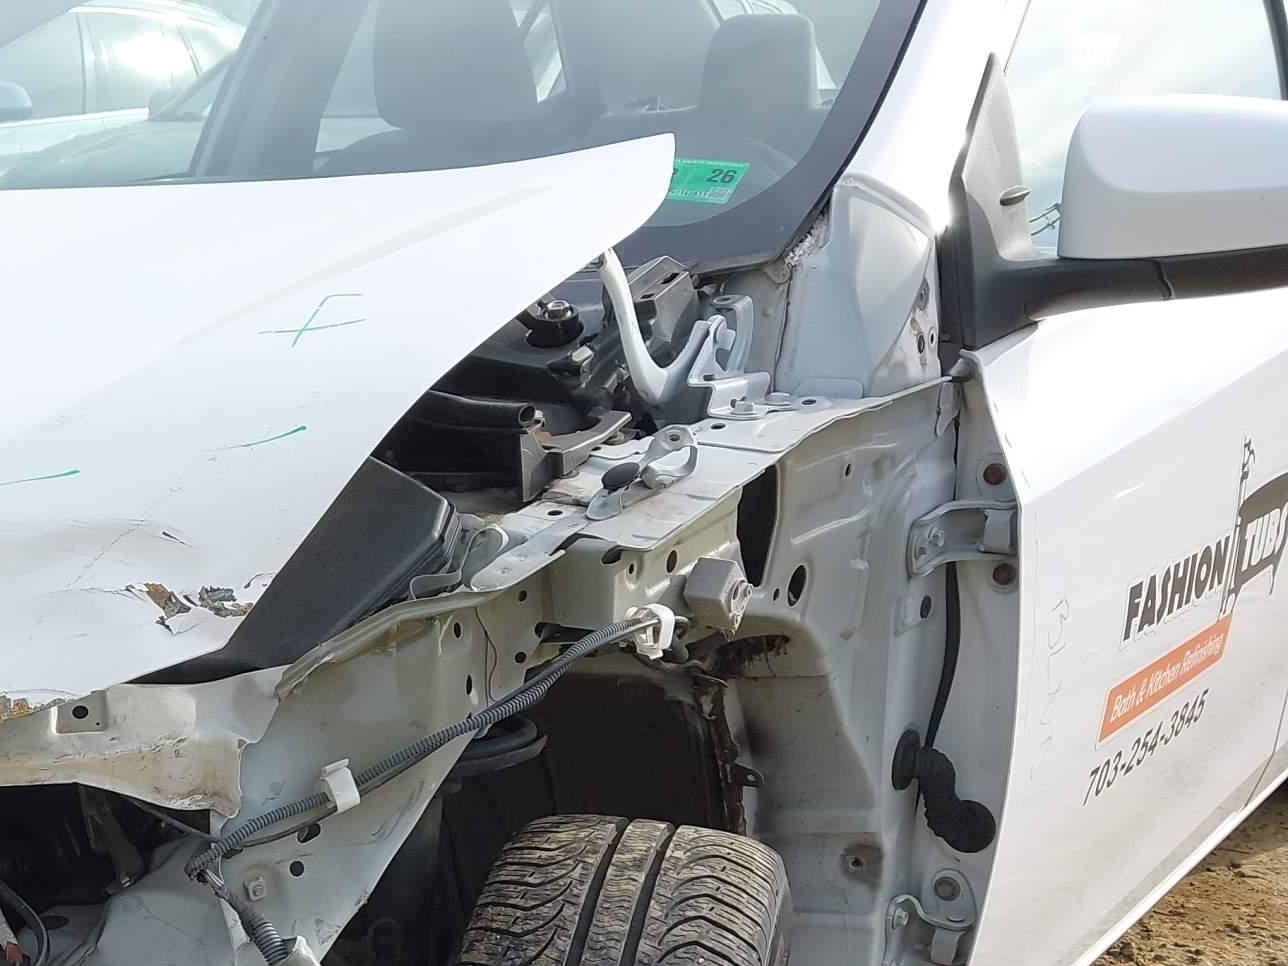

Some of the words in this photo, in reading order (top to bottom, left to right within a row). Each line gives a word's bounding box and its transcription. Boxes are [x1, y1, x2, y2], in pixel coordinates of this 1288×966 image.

[707, 168, 737, 184] 26
[1122, 534, 1232, 642] FASHION
[1242, 501, 1288, 572] TUBS
[1110, 682, 1137, 723] Bath
[1136, 677, 1148, 707] &
[1146, 661, 1182, 698] Kitchen
[1180, 632, 1225, 676] Refinishing
[1083, 687, 1210, 806] 703-254-3845
